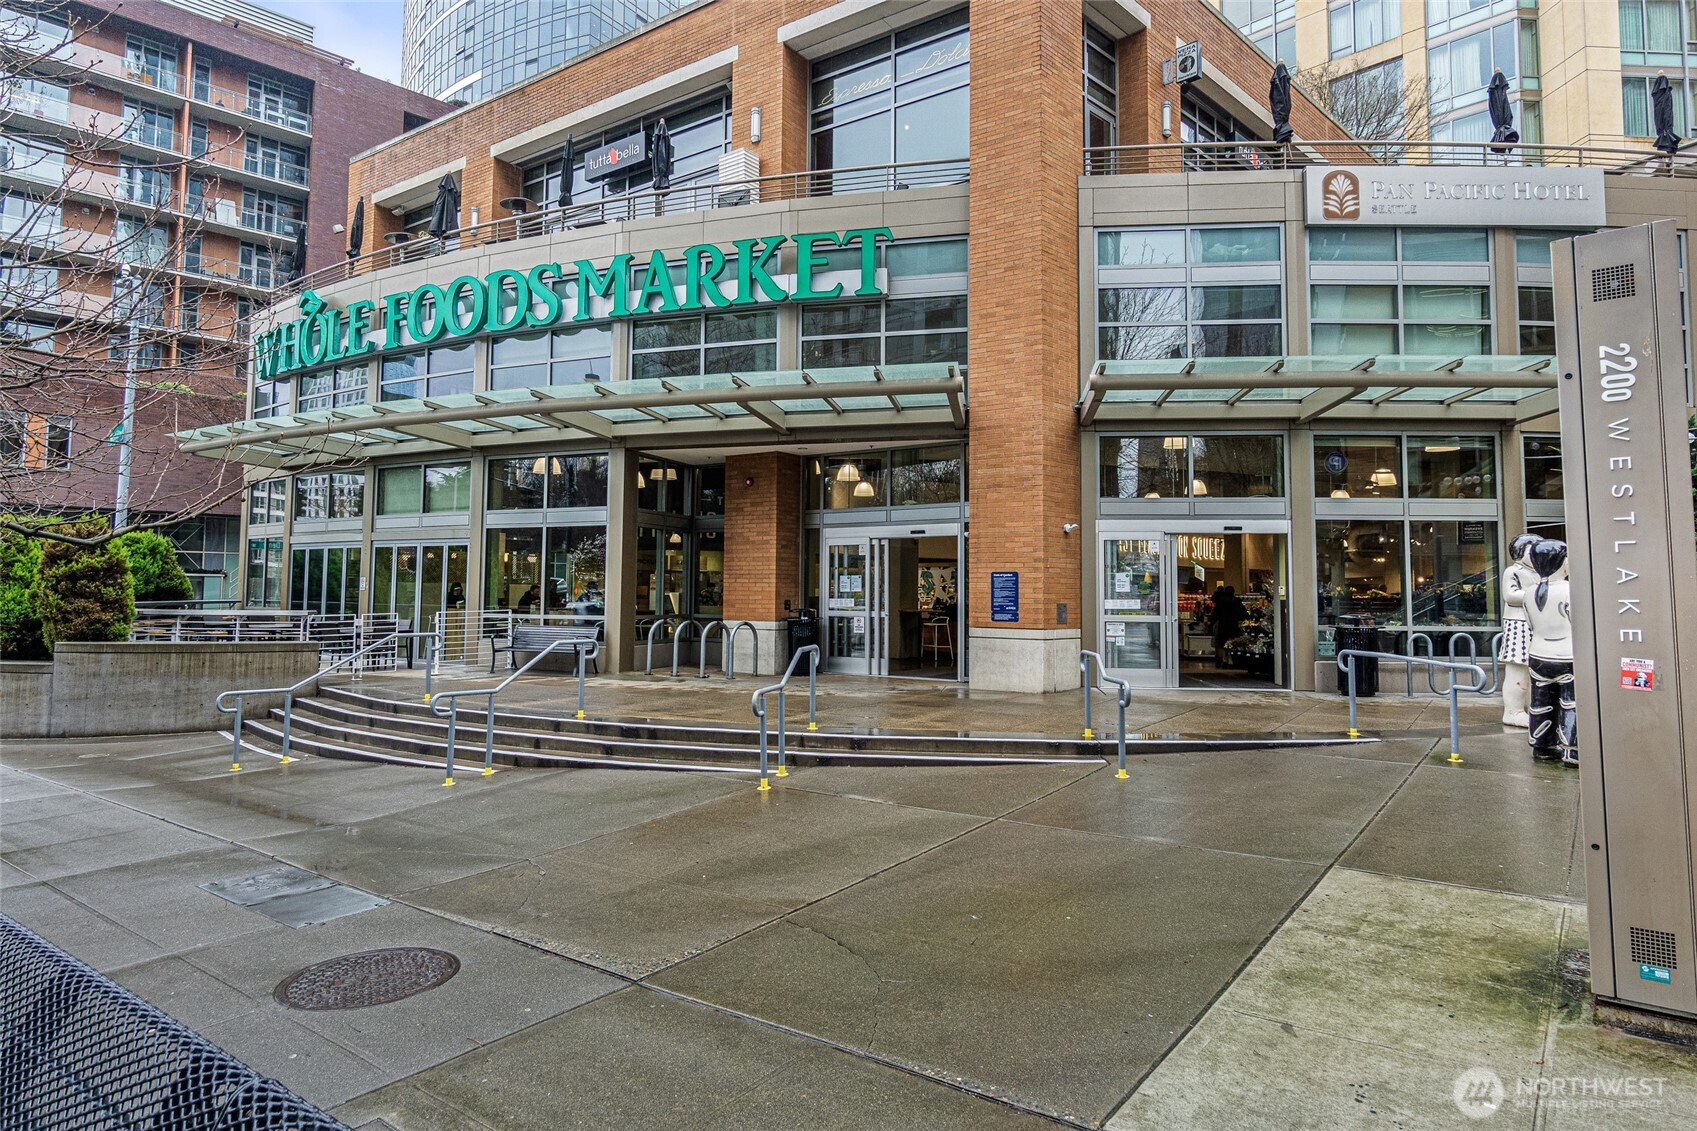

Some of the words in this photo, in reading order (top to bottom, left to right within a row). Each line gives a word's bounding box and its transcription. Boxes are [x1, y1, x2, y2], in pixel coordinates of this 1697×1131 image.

[589, 151, 612, 170] tutta
[615, 143, 640, 161] bella
[1371, 181, 1415, 200] PAN
[1424, 181, 1506, 200] PACIFIC
[1512, 181, 1590, 201] HOTEL
[1371, 204, 1417, 214] SEATTLE
[383, 262, 563, 351] FOODS
[573, 226, 895, 322] MARKET
[1599, 342, 1638, 402] 2200
[1607, 417, 1644, 644] WESTLAKE
